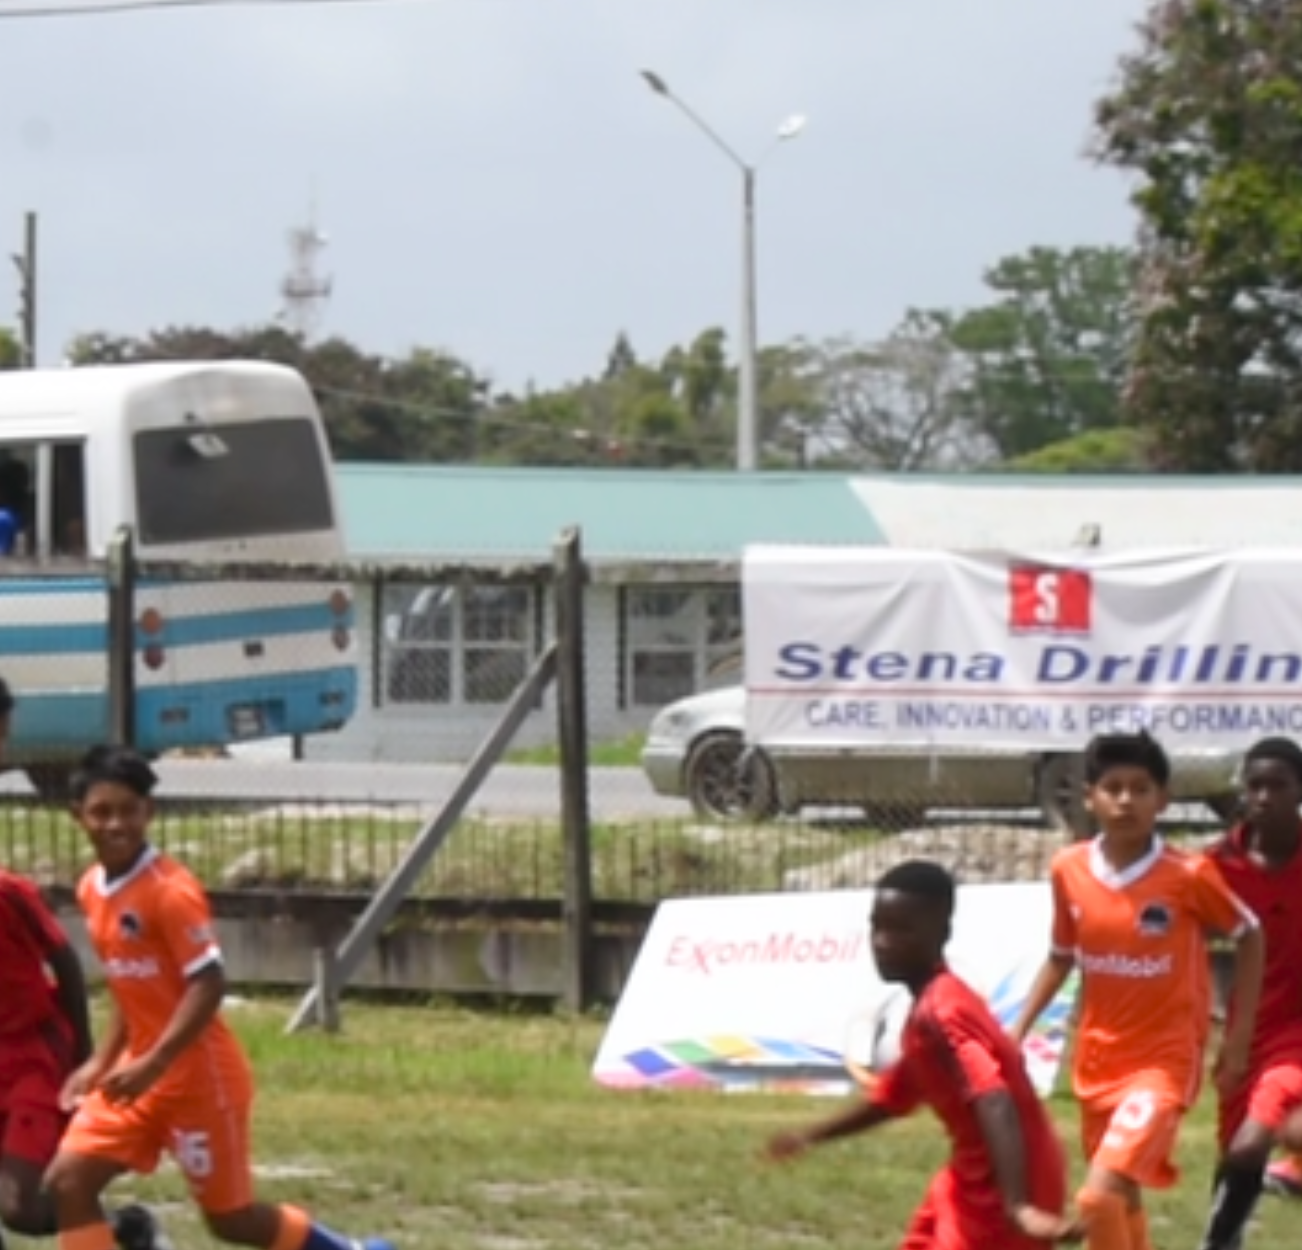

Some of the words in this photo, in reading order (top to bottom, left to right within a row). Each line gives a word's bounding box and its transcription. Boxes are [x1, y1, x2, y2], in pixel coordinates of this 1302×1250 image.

[774, 643, 1004, 681] Stena
[805, 702, 888, 730] CARE,
[897, 703, 1049, 731] INNOVATION
[1060, 706, 1076, 732] &
[665, 932, 862, 977] ExxonMobil
